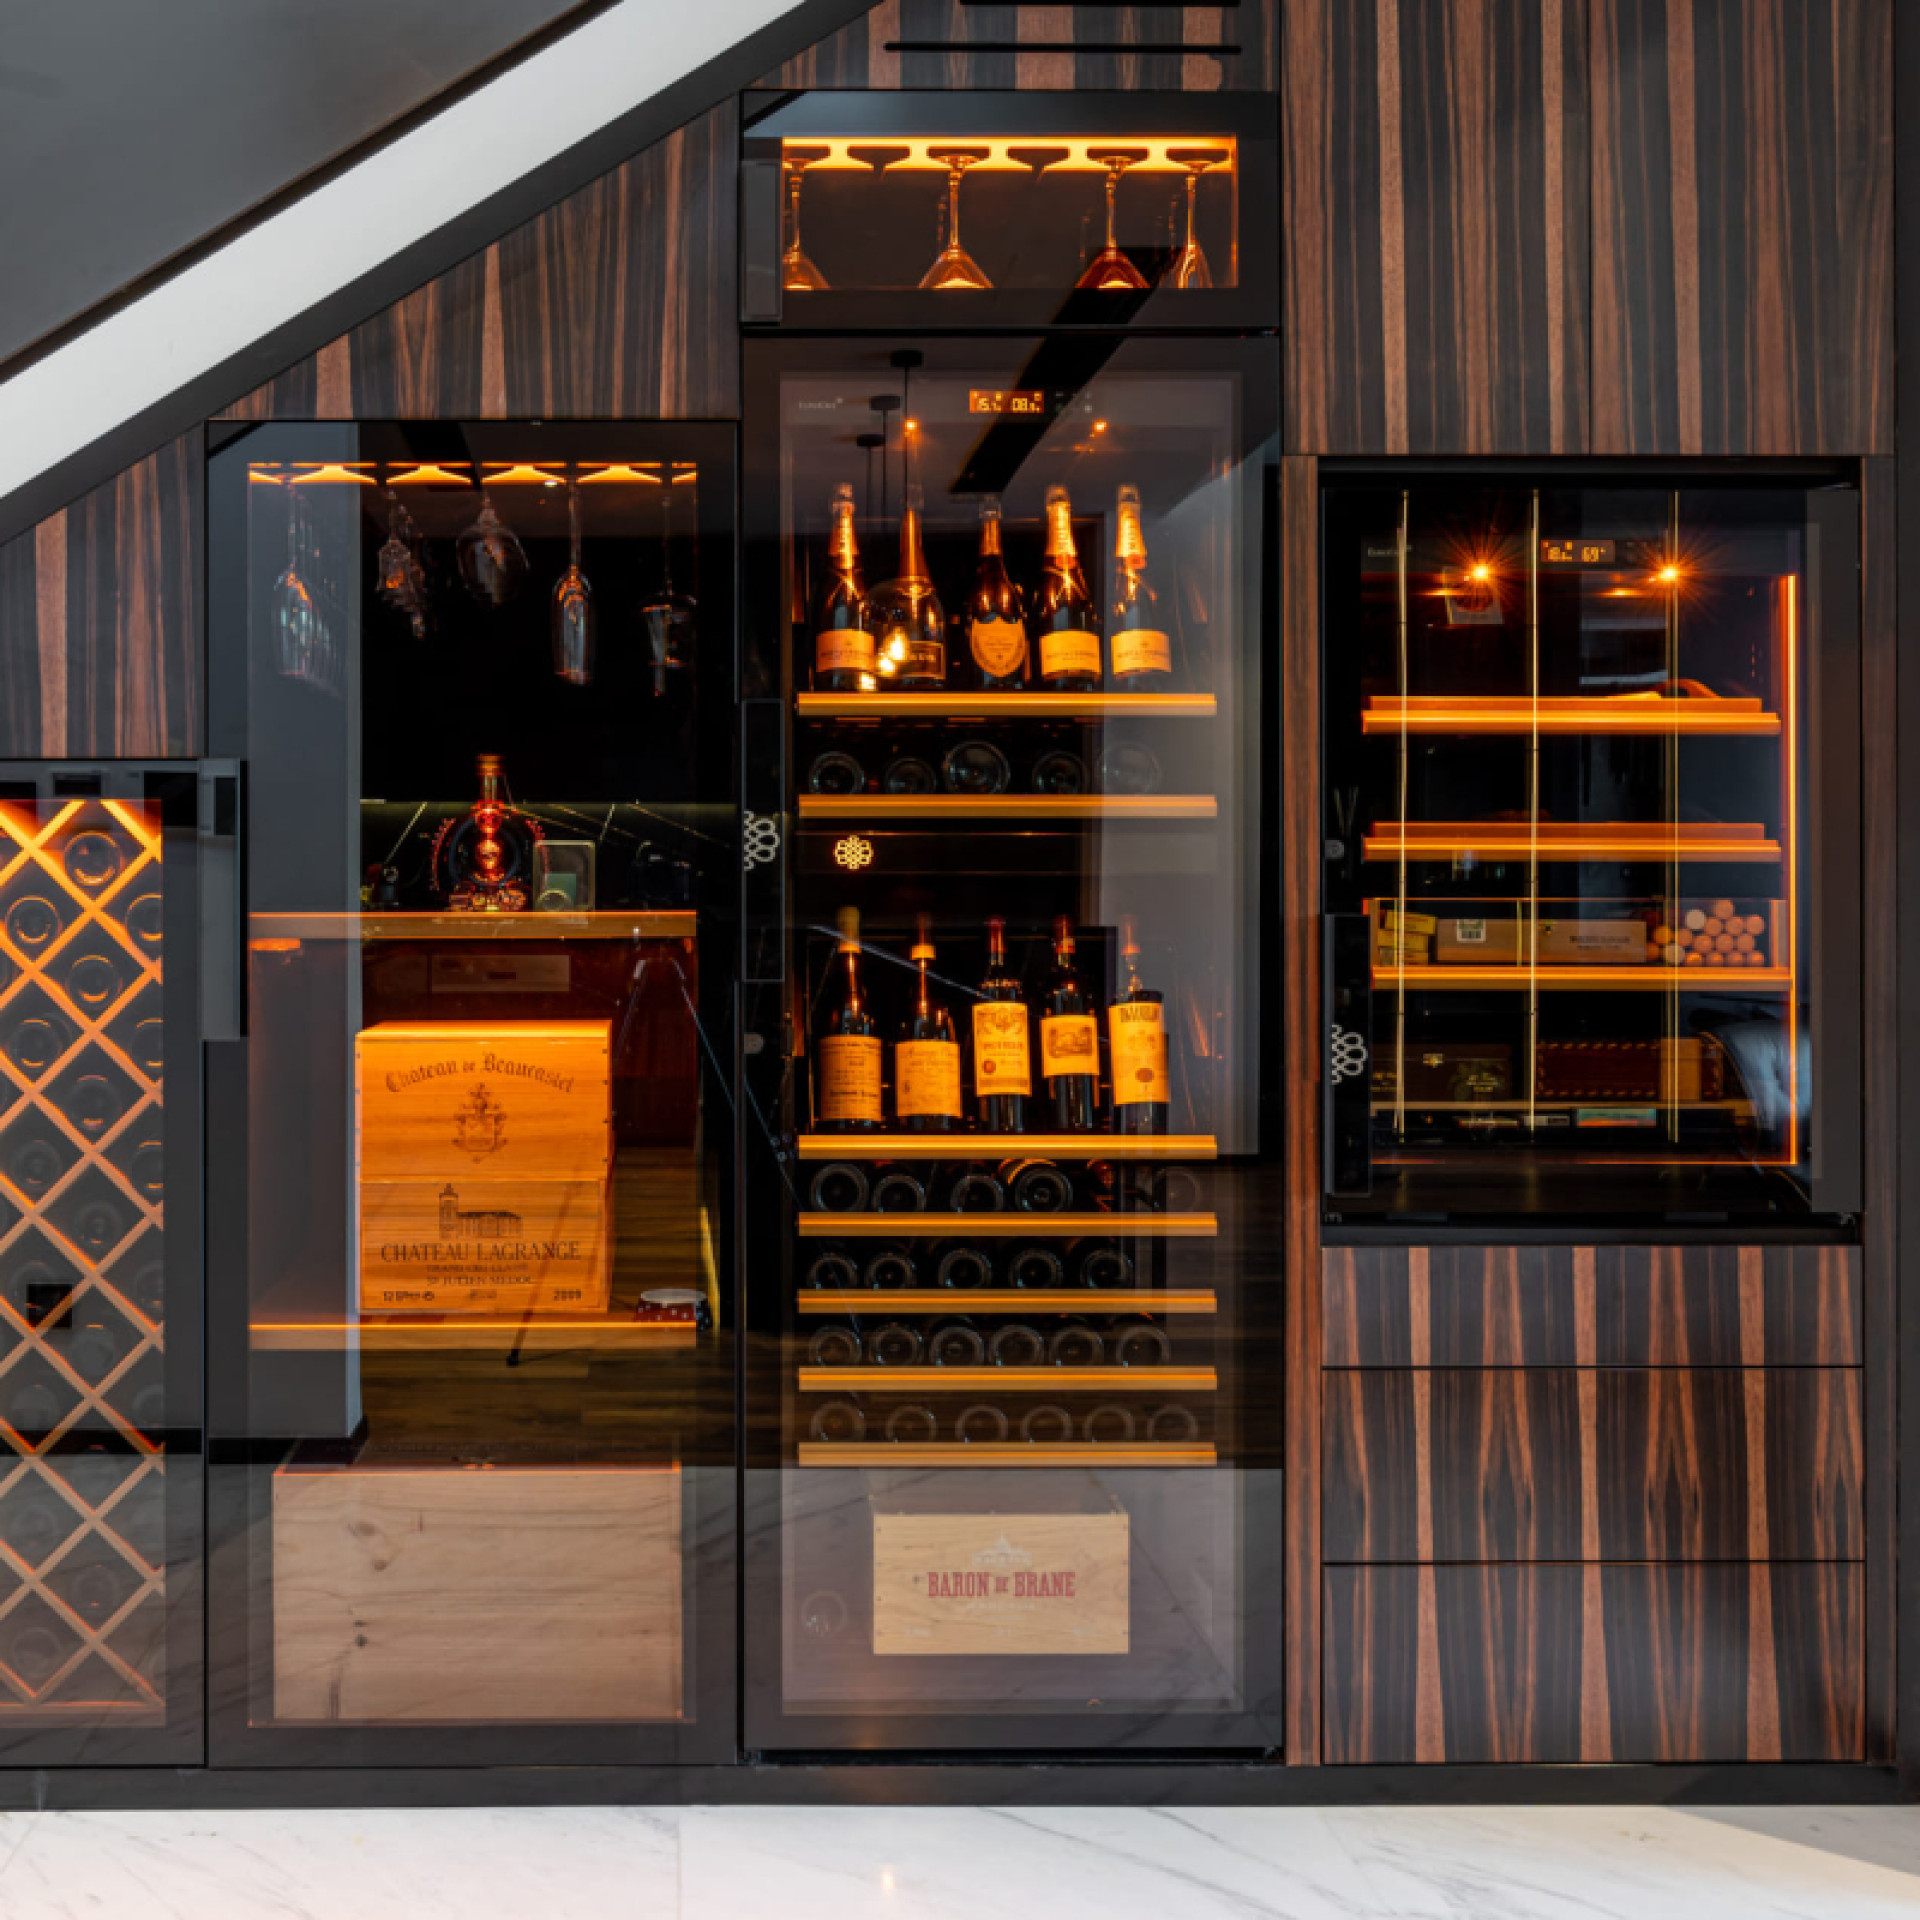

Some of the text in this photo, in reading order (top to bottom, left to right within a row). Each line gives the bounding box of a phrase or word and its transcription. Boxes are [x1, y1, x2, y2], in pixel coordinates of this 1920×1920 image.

[476, 1240, 582, 1261] LAGRANGE
[928, 1571, 990, 1598] BARON
[1013, 1571, 1076, 1598] BRANE
